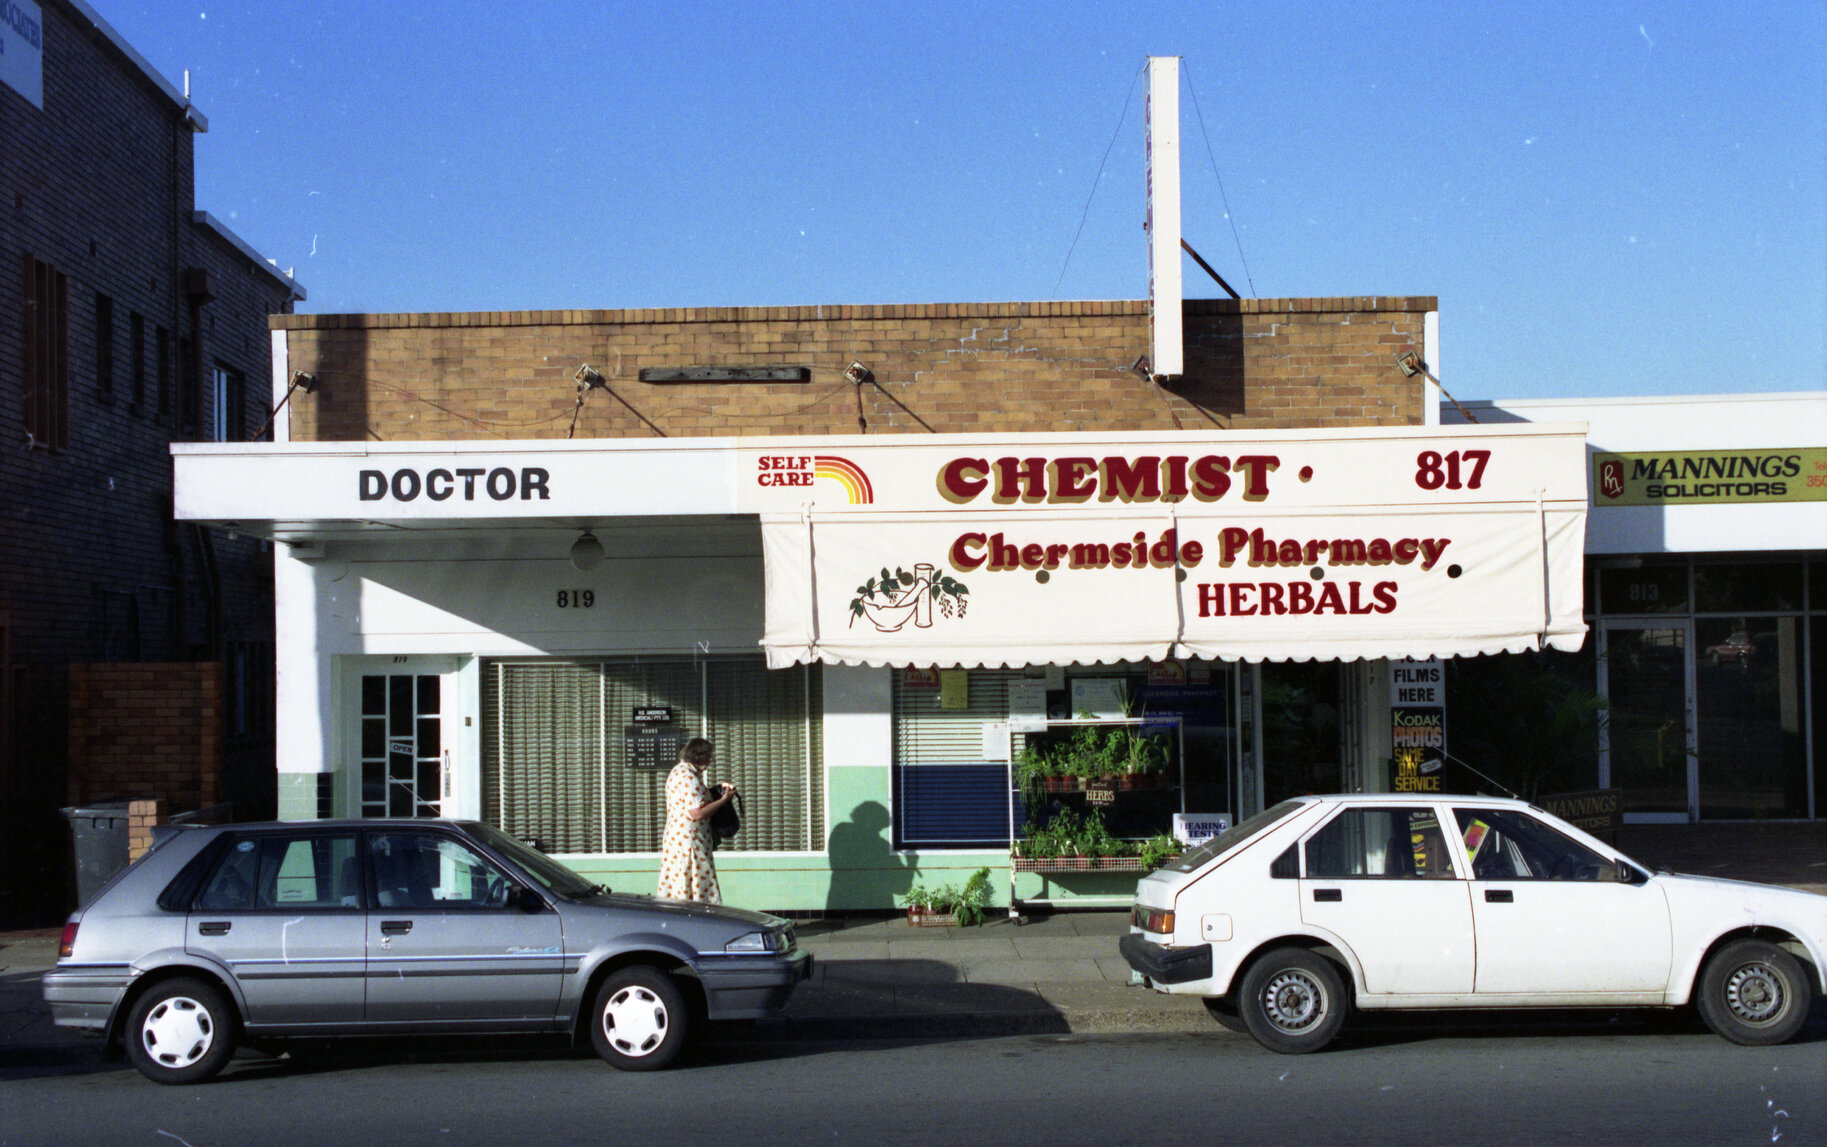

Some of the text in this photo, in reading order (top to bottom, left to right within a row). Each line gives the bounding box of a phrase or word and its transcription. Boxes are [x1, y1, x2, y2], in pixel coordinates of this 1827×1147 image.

[759, 455, 811, 471] SELF
[1415, 449, 1491, 490] 817
[1631, 455, 1802, 481] MANNINGS
[359, 467, 551, 502] DOCTOR
[758, 472, 814, 487] CARE
[936, 455, 1281, 505] CHEMIST
[1646, 482, 1788, 499] SOLICITORS
[948, 527, 1452, 572] Chermside Pharmacy
[556, 589, 595, 609] 819
[1197, 581, 1399, 618] HERBALS
[1629, 583, 1659, 602] 813
[1394, 668, 1440, 683] FILMS
[1399, 688, 1435, 702] HERE
[1393, 726, 1443, 747] PHOTOS
[393, 744, 413, 754] OPEN
[1394, 748, 1425, 762] SAME
[1398, 762, 1419, 777] DAY
[1395, 776, 1441, 792] SERVICE
[1546, 793, 1617, 817] MANNINGS
